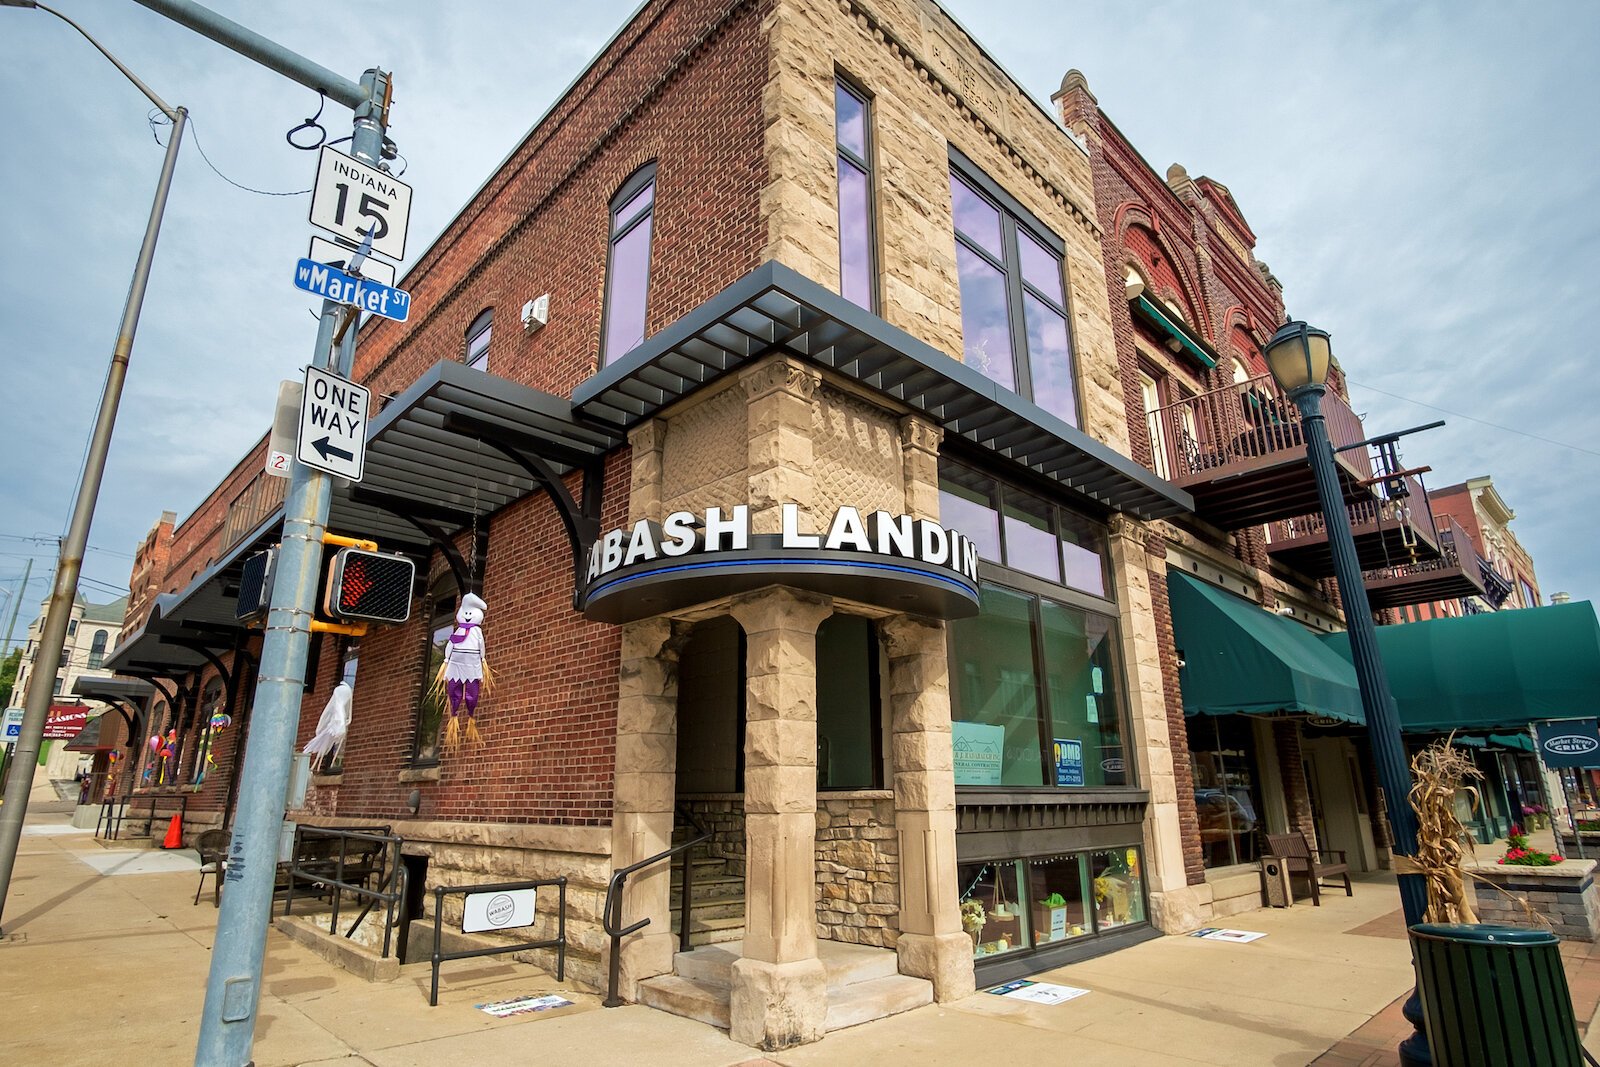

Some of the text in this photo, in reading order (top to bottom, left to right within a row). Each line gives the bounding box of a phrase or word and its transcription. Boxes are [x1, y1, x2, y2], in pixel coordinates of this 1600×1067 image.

[334, 160, 398, 200] INDIANA
[335, 182, 389, 240] 15
[299, 265, 407, 314] W Market ST
[314, 378, 361, 415] ONE
[311, 402, 360, 439] WAY
[274, 455, 285, 469] 2
[586, 503, 978, 585] ABASH LANDIN
[1061, 743, 1080, 760] DMB
[1549, 737, 1592, 747] Market Street
[489, 903, 512, 916] WABASH
